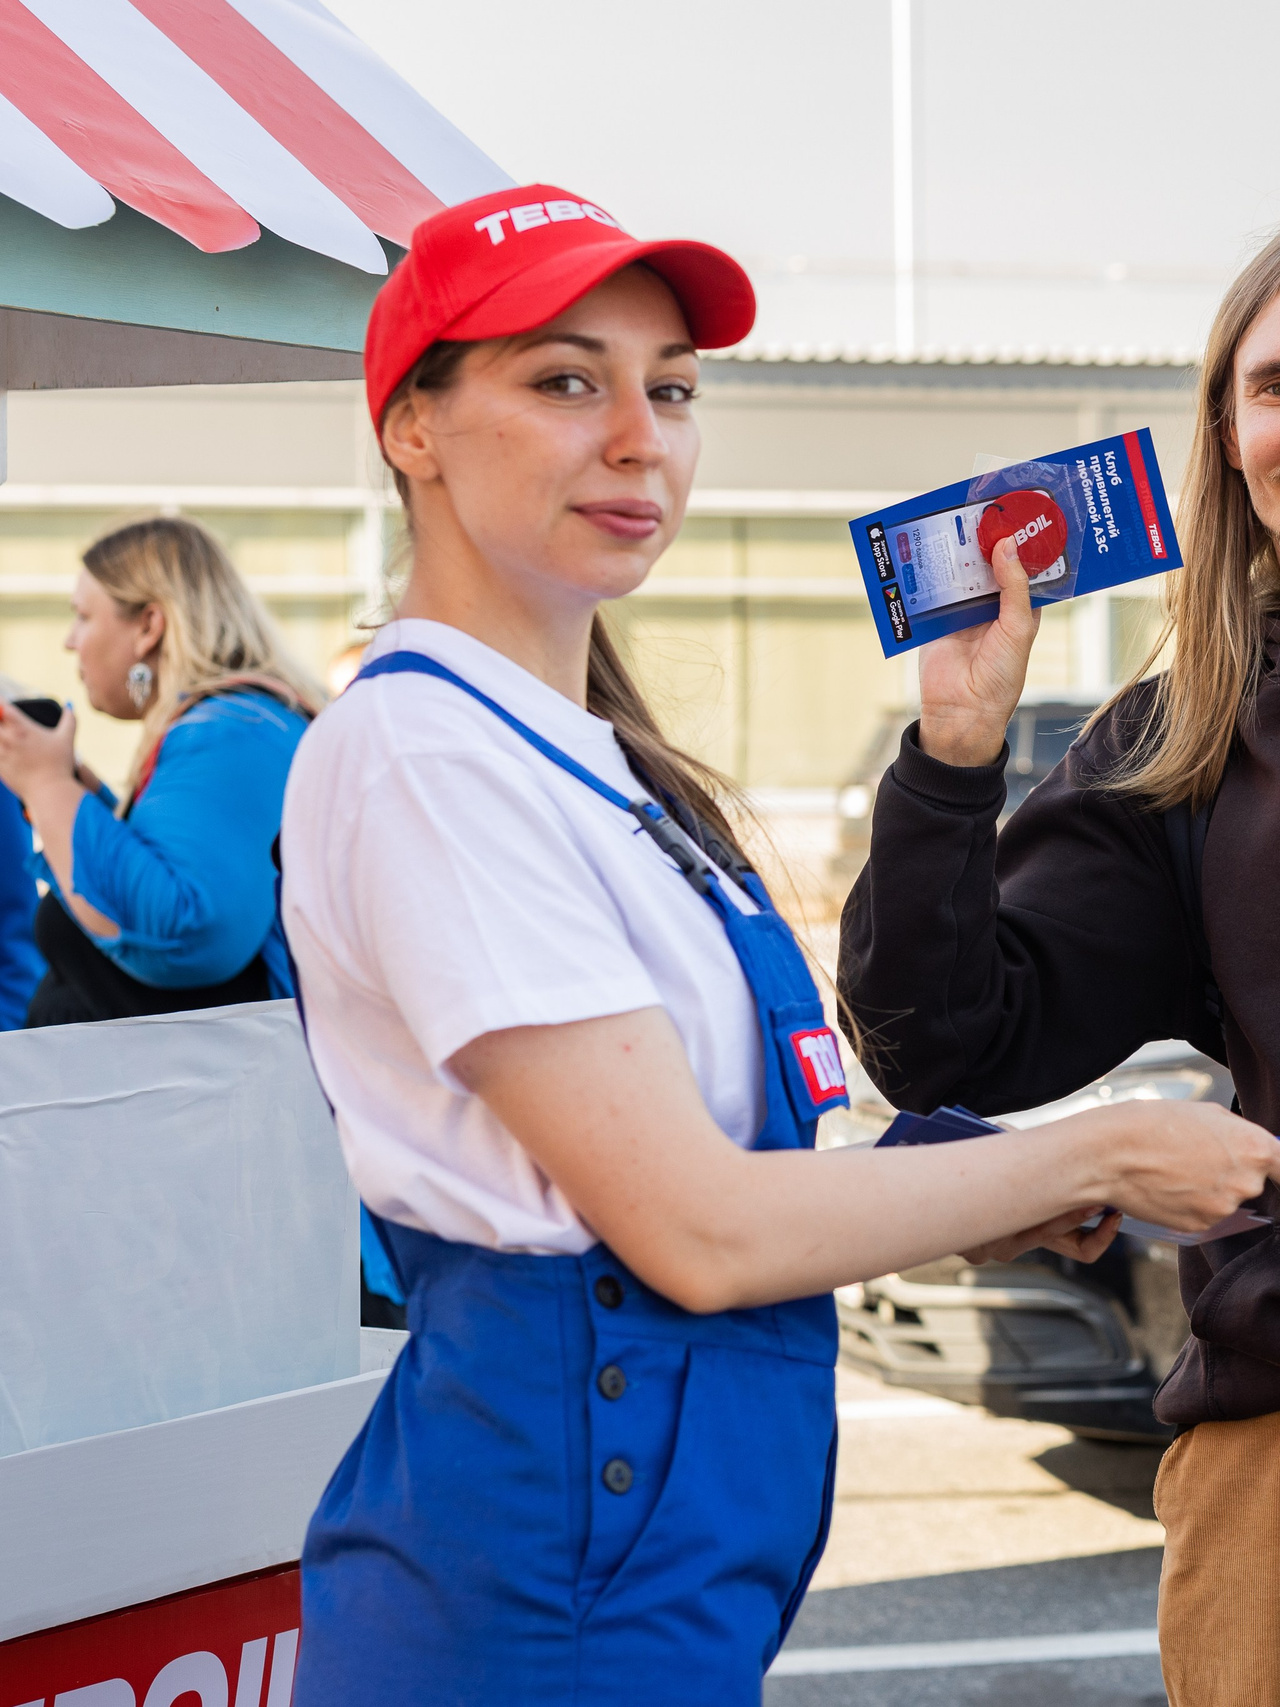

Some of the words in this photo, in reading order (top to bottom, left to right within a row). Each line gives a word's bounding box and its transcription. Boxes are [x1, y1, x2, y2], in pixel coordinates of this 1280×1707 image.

[1104, 450, 1122, 486] Клуб
[1076, 460, 1102, 524] любимой
[1093, 526, 1109, 554] АЗС
[1090, 455, 1120, 539] привилегий
[912, 528, 922, 547] 1290
[1148, 523, 1163, 556] TEBOIL
[872, 542, 882, 556] App
[877, 555, 887, 578] Store
[889, 601, 901, 625] Google
[896, 624, 904, 639] Play
